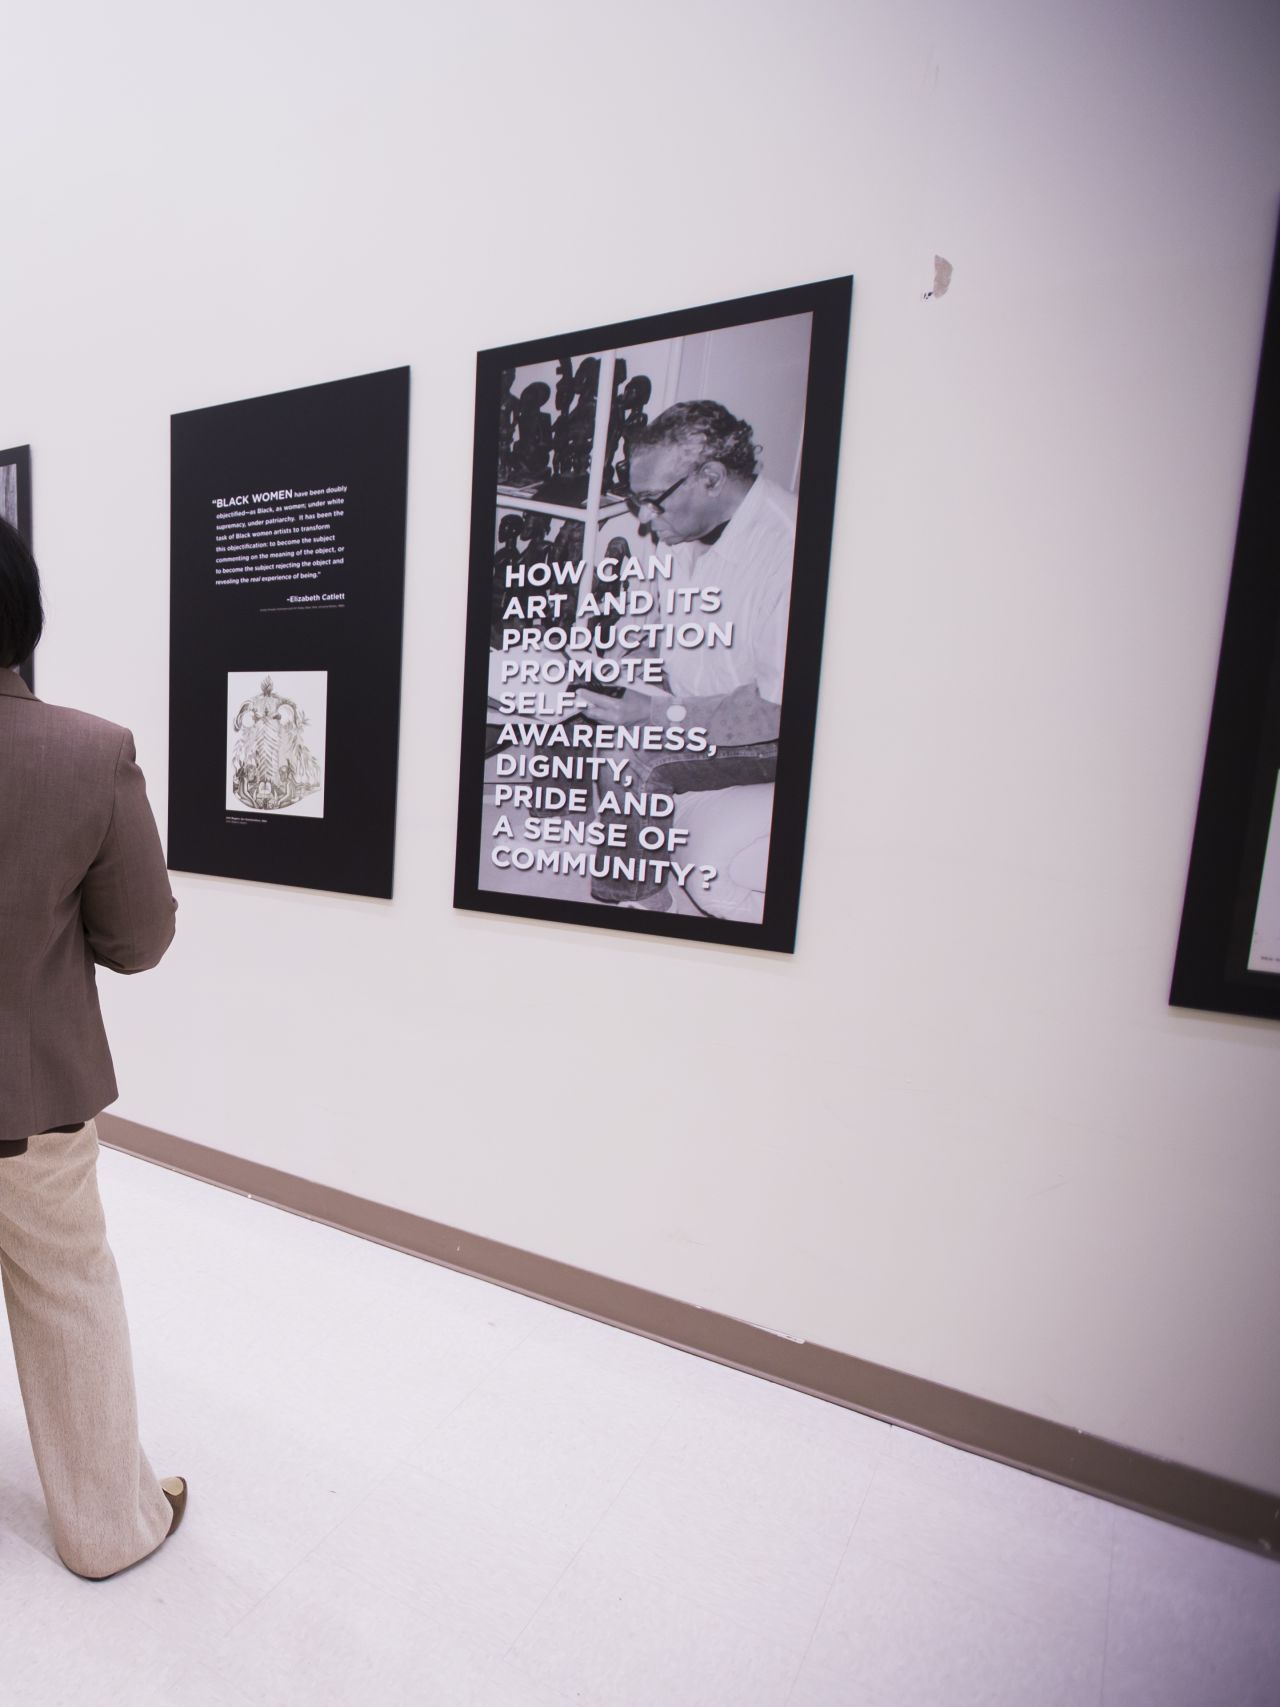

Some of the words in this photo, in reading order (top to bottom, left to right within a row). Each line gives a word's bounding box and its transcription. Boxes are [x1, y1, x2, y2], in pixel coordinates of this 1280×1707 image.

[212, 495, 249, 508] “BLACK
[252, 489, 293, 503] WOMEN
[326, 485, 348, 493] doubly
[308, 500, 325, 508] under
[265, 516, 296, 525] patriarchy.
[317, 511, 332, 519] been
[301, 524, 331, 532] transform
[313, 534, 336, 543] subject
[216, 555, 249, 564] commenting
[270, 550, 294, 558] meaning
[255, 563, 274, 571] subject
[276, 561, 300, 570] rejecting
[312, 558, 331, 567] object
[216, 577, 239, 585] revealing
[261, 574, 292, 582] experience
[505, 560, 586, 588] HOW
[597, 555, 672, 583] CAN
[322, 592, 345, 601] Catlett
[502, 594, 568, 620] ART
[578, 591, 653, 617] AND
[667, 586, 722, 614] ITS
[502, 622, 734, 652] PRODUCTION
[501, 658, 664, 684] PROMOTE
[499, 692, 587, 715] SELF-
[497, 723, 718, 756] AWARENESS,
[496, 754, 633, 785] DIGNITY,
[495, 785, 588, 812] PRIDE
[598, 791, 675, 817] AND
[492, 816, 514, 838] A
[524, 817, 627, 847] SENSE
[639, 826, 689, 852] OF
[491, 846, 719, 889] COMMUNITY?
